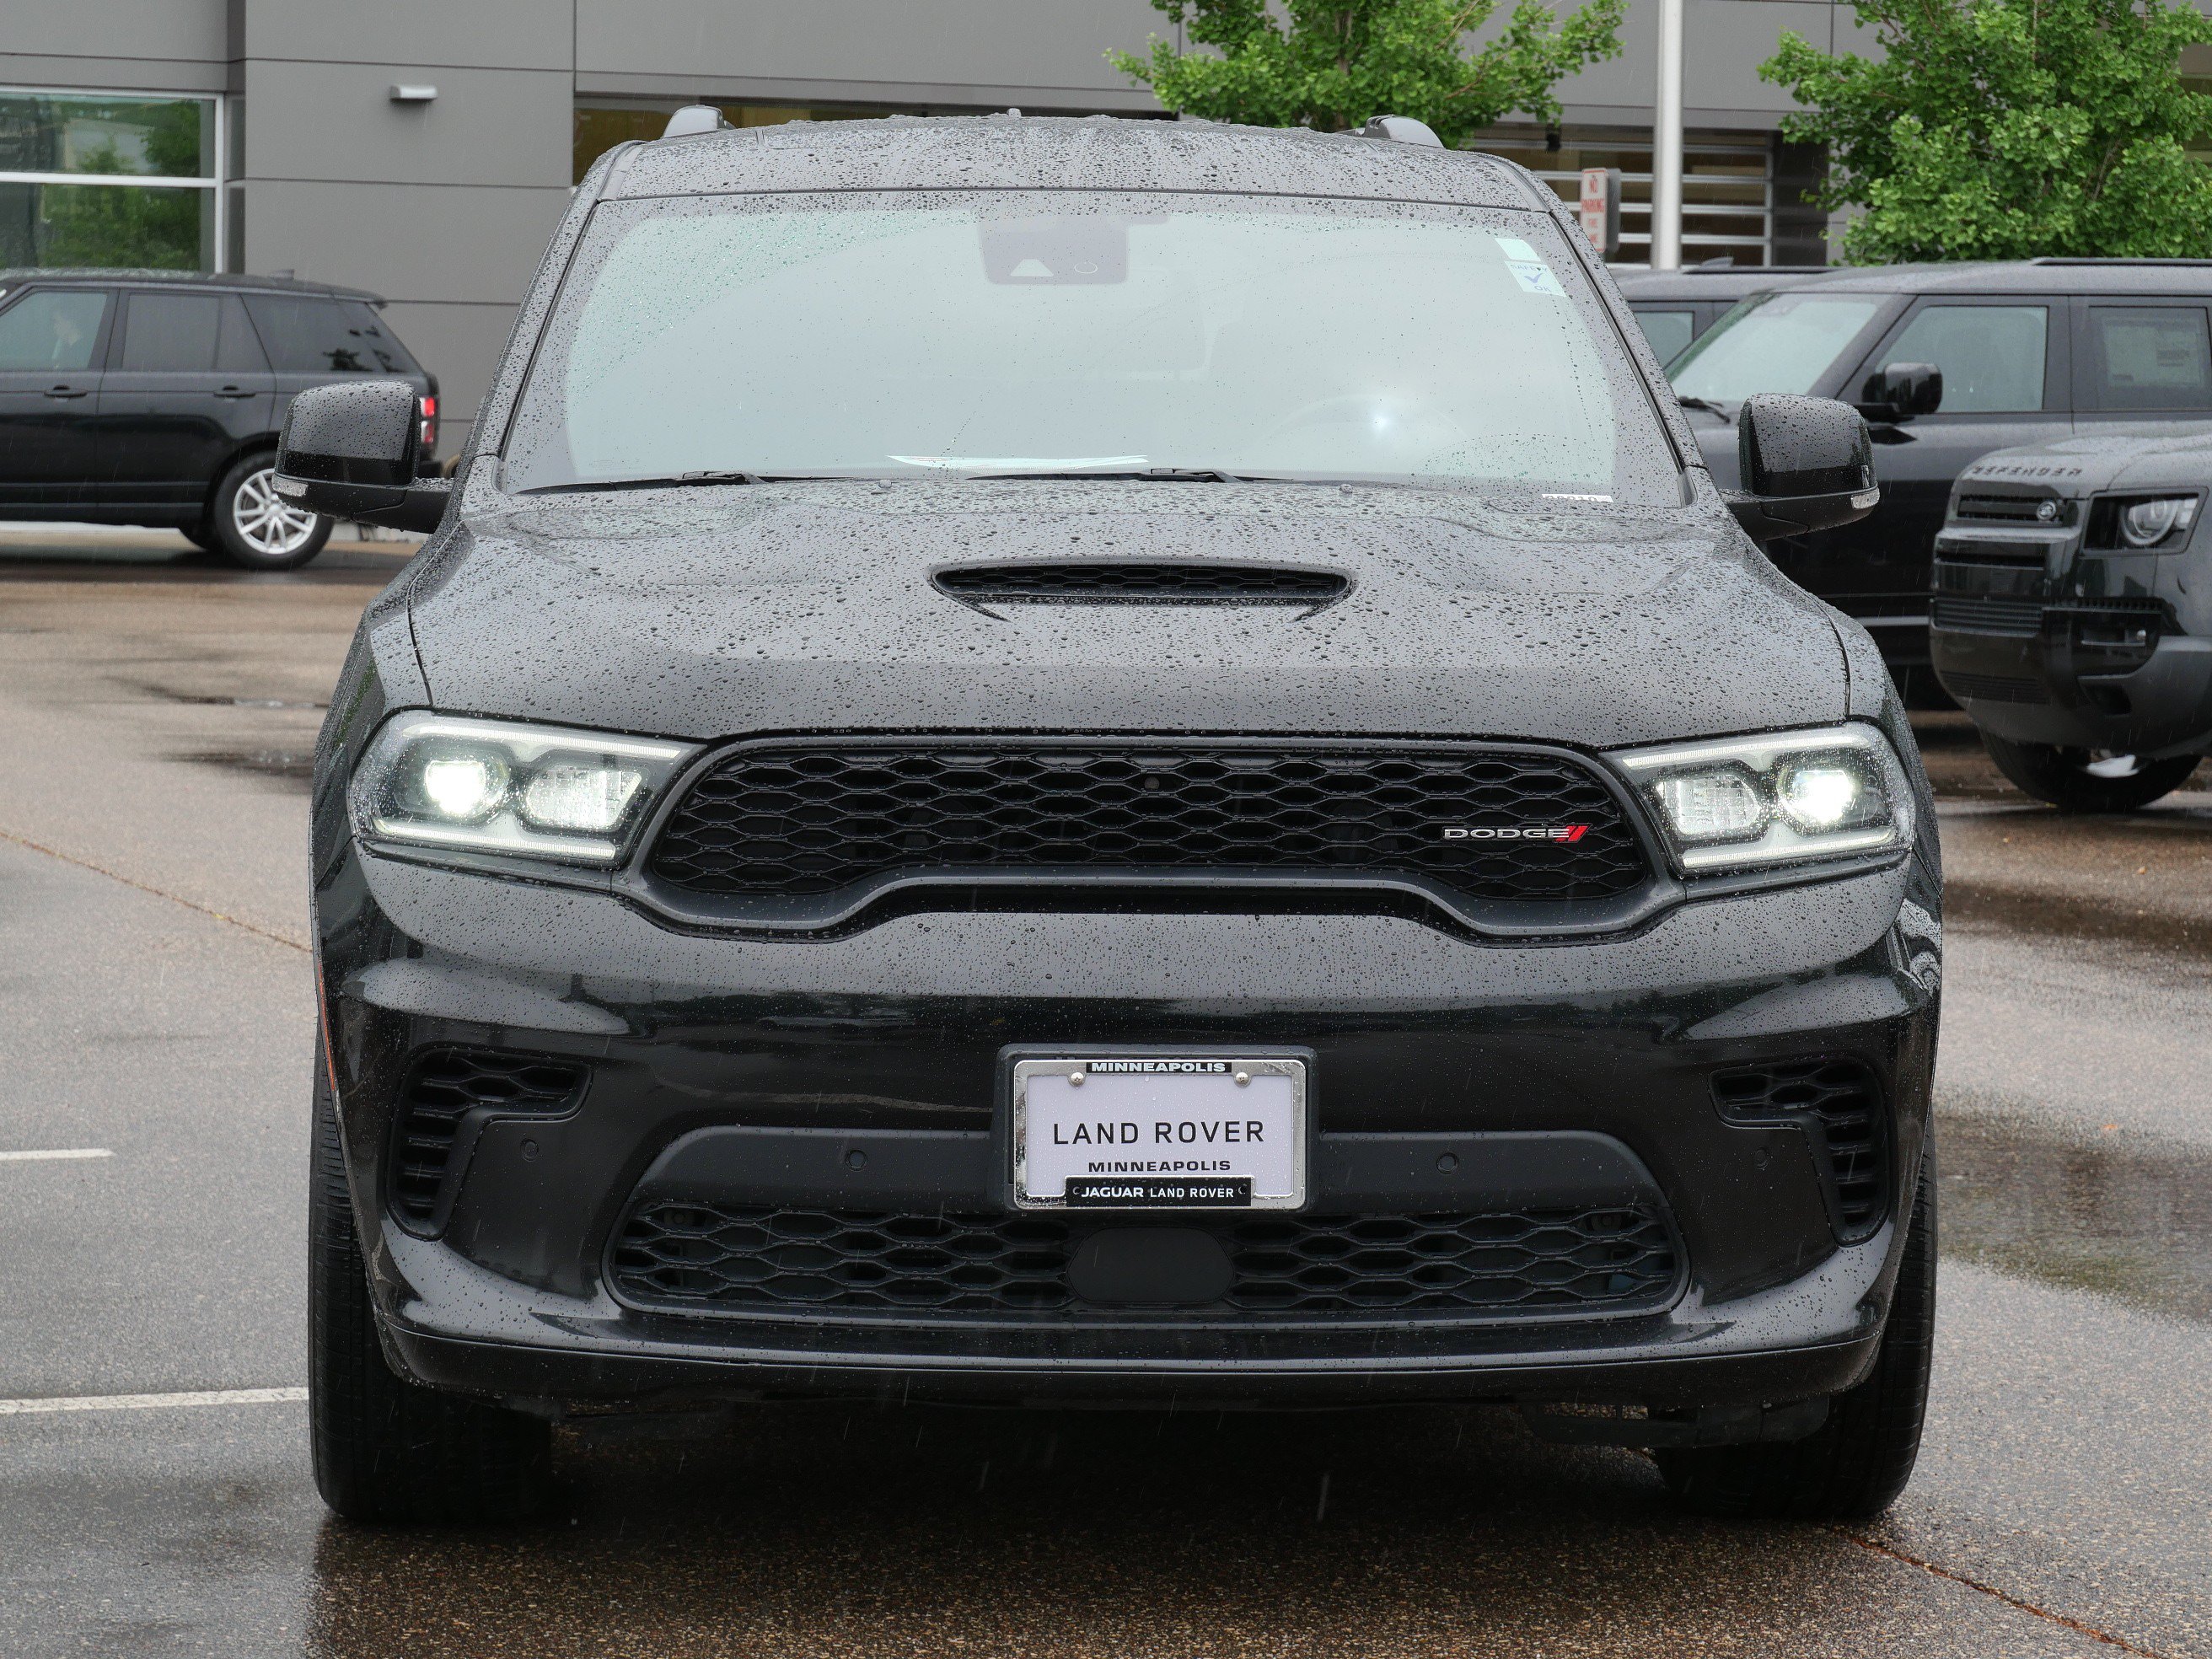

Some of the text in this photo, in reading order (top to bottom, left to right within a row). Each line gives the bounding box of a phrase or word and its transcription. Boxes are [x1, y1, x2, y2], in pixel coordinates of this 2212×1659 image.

[1444, 828, 1570, 839] DODGE
[1091, 1062, 1226, 1072] MINNEAPOLIS
[1053, 1120, 1264, 1145] LAND ROVER
[1088, 1160, 1231, 1172] MINNEAPOLIS
[1081, 1186, 1234, 1199] JAGUAR LAND ROVER
